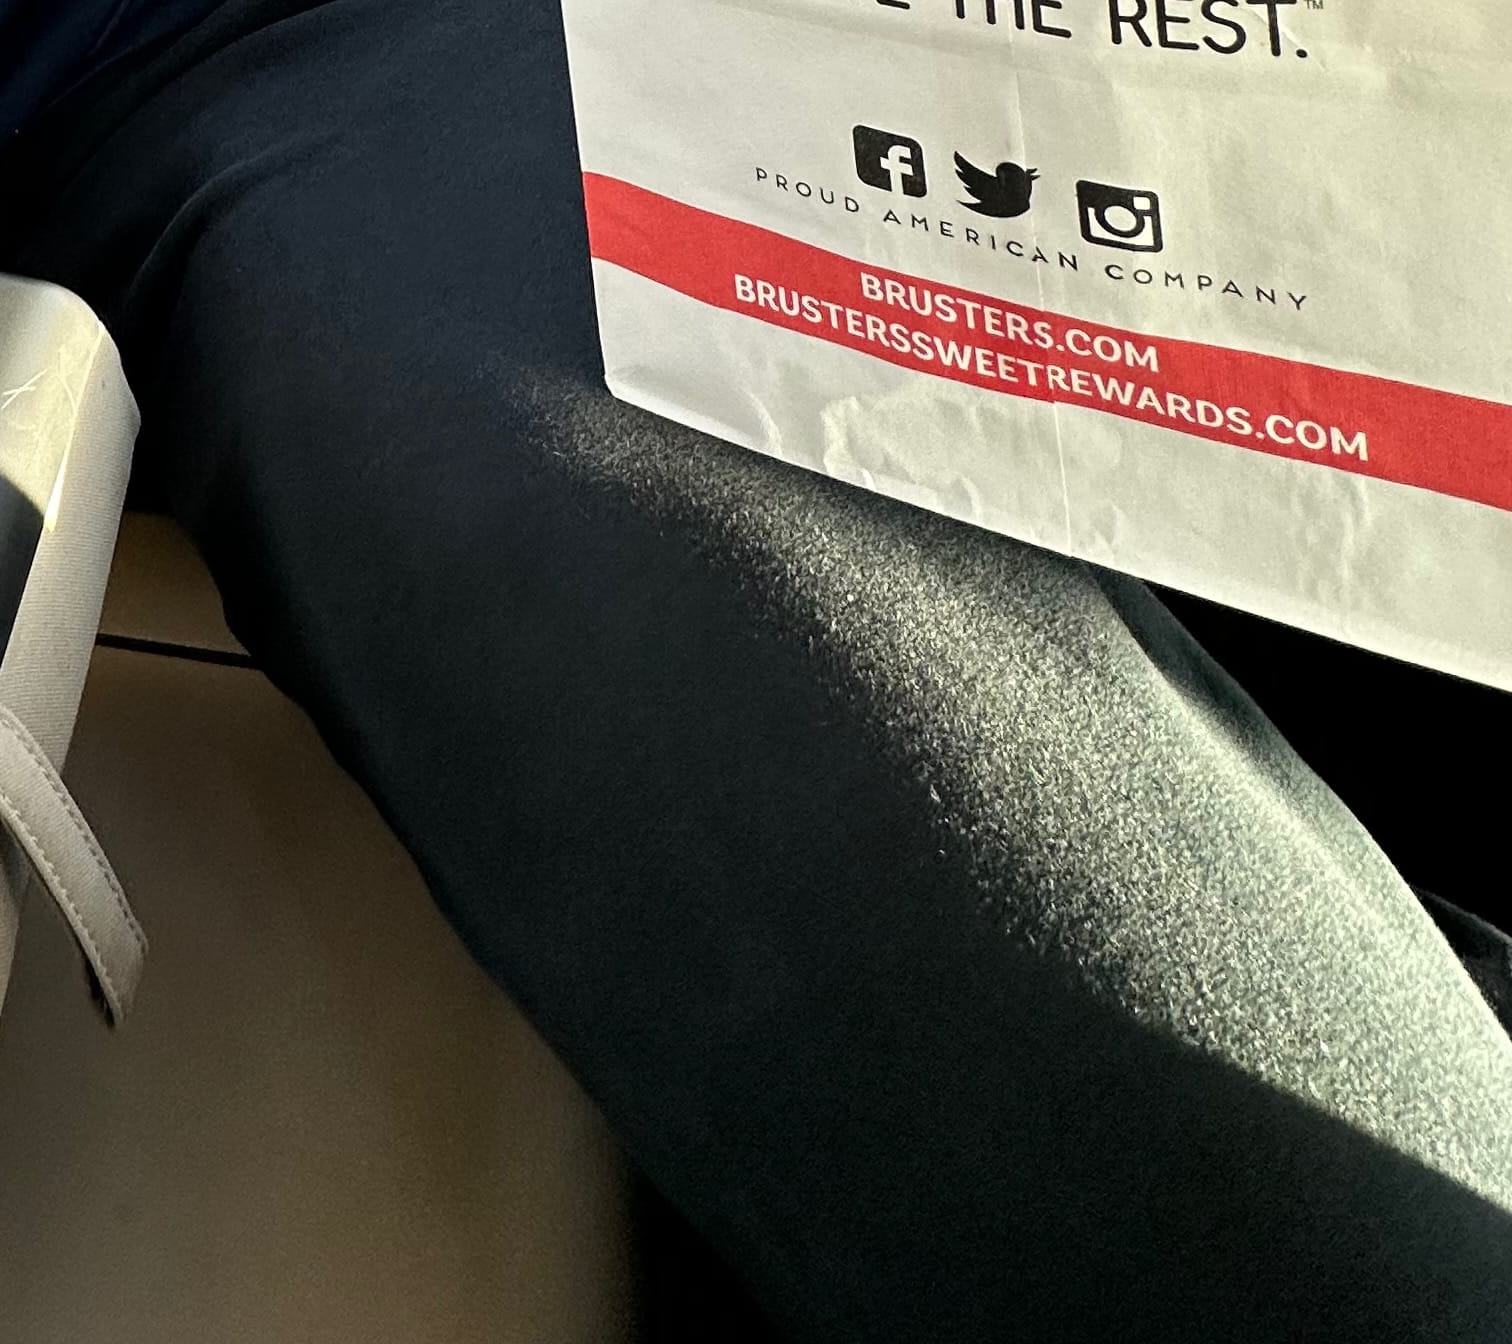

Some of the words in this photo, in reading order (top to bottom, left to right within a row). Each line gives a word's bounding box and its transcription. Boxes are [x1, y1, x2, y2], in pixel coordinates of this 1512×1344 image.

[754, 166, 861, 214] PROUD
[882, 208, 1078, 272] AMERICAN
[1103, 263, 1308, 312] COMPANY
[734, 273, 1369, 462] BRUSTERSSWEETREWARDS.COM
[860, 271, 1159, 373] BRUSTERS.COM
